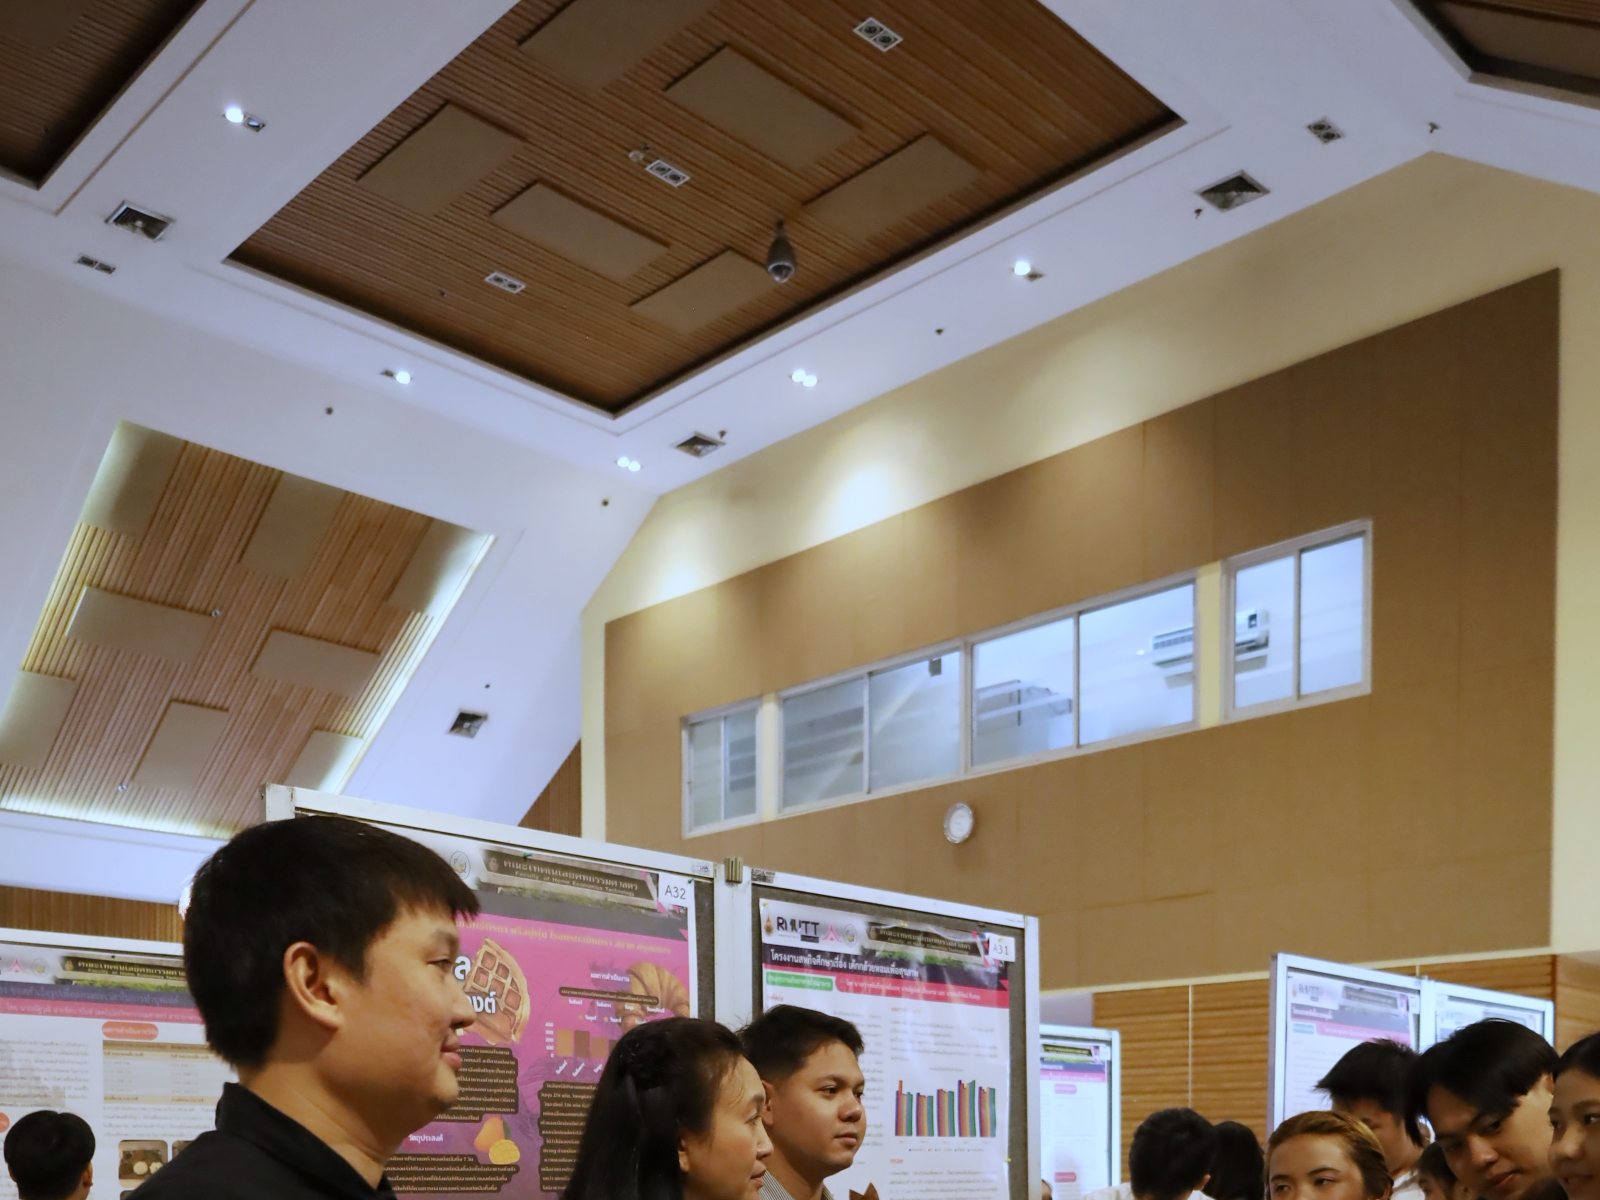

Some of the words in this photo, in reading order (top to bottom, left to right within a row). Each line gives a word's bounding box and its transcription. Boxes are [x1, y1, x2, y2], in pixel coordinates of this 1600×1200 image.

[515, 870, 540, 880] Faculty
[552, 876, 570, 886] Home
[572, 880, 603, 891] Economics
[605, 886, 635, 897] Technology
[664, 884, 686, 900] A32
[992, 942, 1009, 956] A31
[408, 1134, 444, 1144] วัตถุประสงค์
